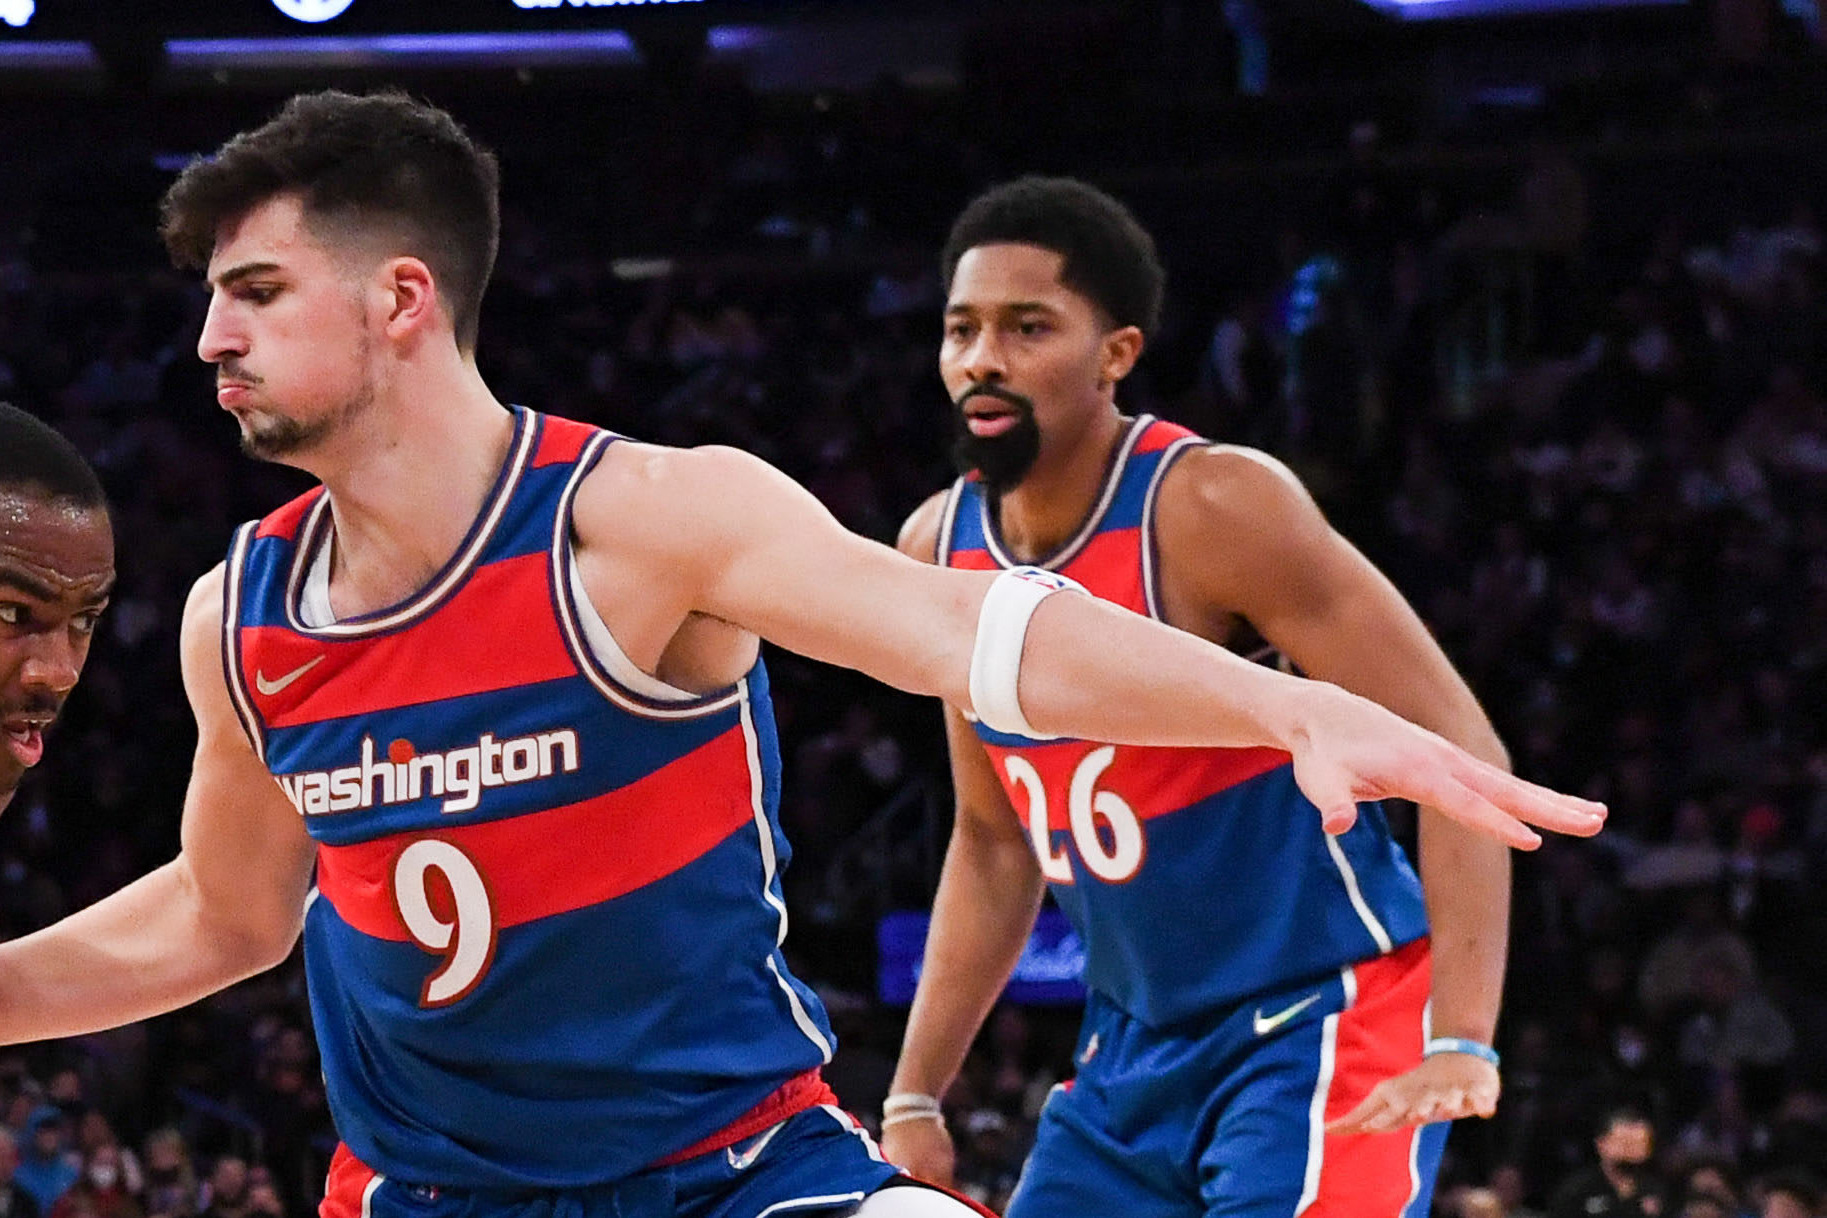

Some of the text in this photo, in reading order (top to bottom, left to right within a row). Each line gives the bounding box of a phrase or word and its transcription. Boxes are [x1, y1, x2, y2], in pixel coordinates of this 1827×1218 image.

[273, 729, 580, 816] washington
[1002, 743, 1147, 886] 26
[388, 832, 499, 1009] 9
